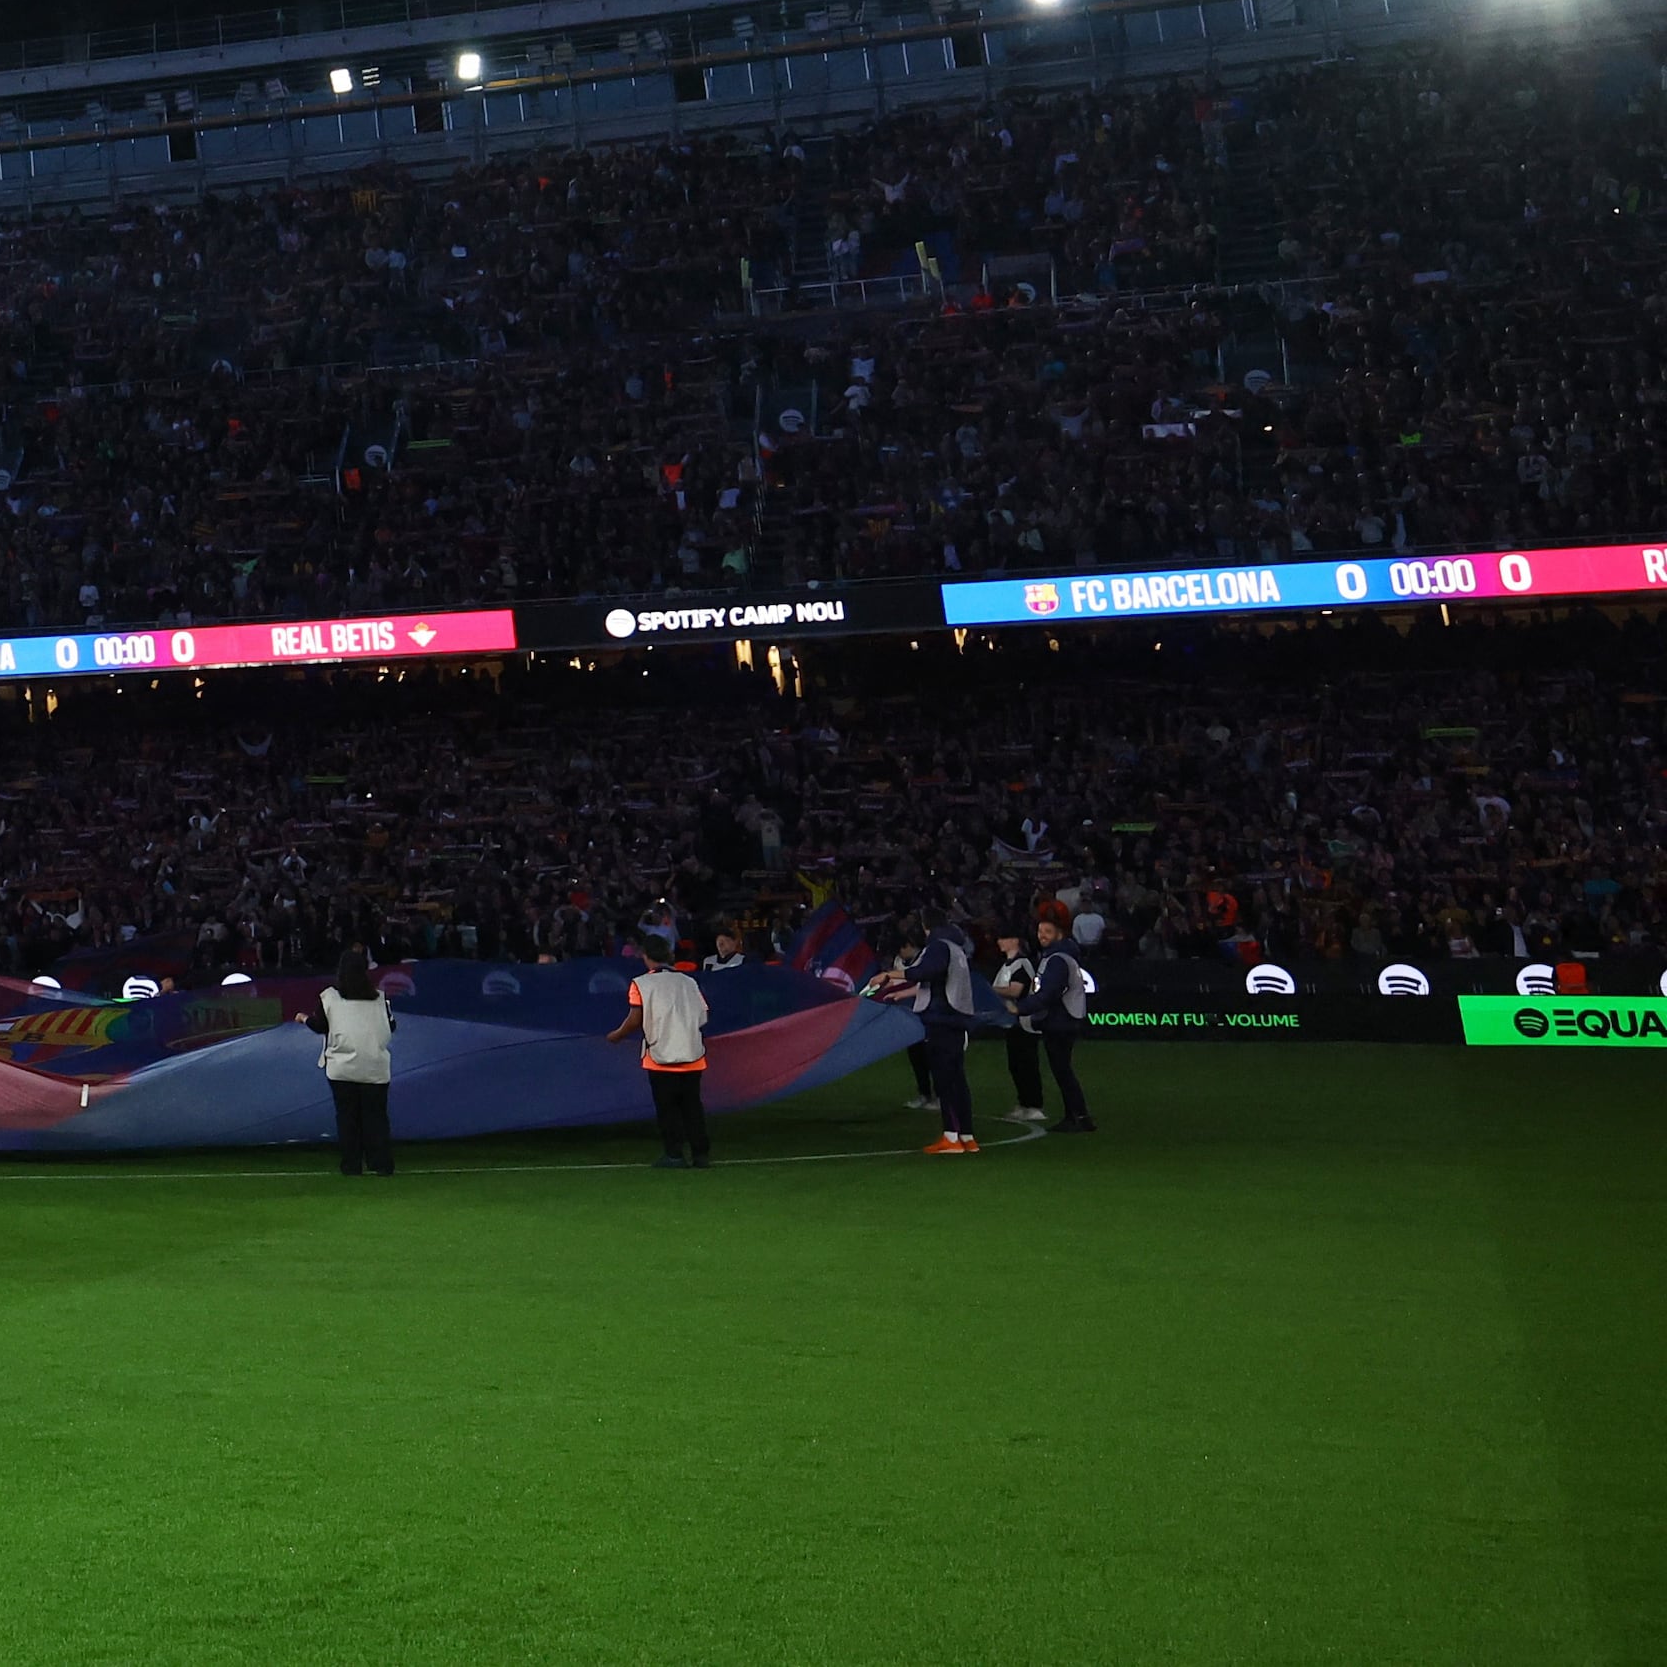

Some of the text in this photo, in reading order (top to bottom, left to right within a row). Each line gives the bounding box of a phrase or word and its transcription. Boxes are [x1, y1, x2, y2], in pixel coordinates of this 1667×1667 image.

[1070, 547, 1667, 613] FC BARCELONA 0 00:00 0 R
[637, 600, 845, 632] SPOTIFY CAMP NOU
[55, 638, 78, 669] 0
[94, 635, 156, 666] 00:00
[171, 632, 195, 663] 0
[272, 625, 327, 656] REAL
[331, 621, 394, 653] BETIS
[1087, 1013, 1300, 1027] WOMEN AT FU VOLUME
